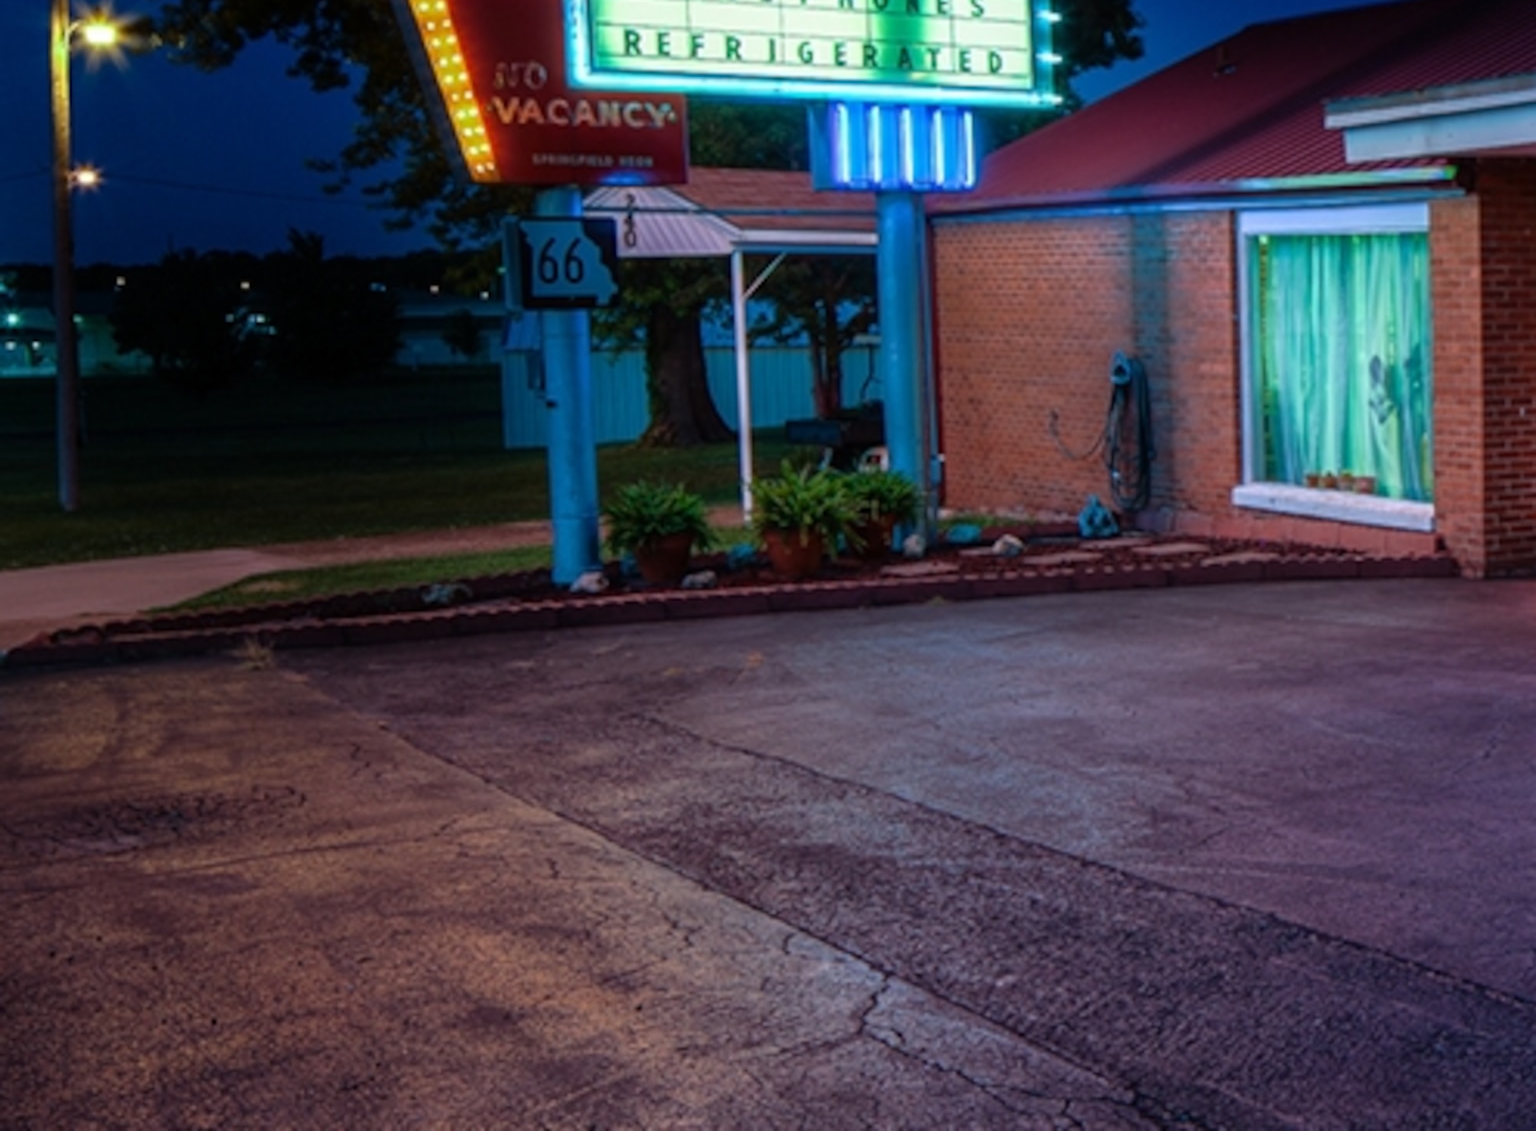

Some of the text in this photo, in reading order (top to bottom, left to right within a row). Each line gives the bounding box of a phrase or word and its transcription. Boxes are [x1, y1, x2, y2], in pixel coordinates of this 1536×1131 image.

[623, 29, 1003, 74] REFRIGERATED
[494, 61, 548, 90] NO
[492, 96, 673, 128] VACANCY
[538, 237, 584, 284] 66
